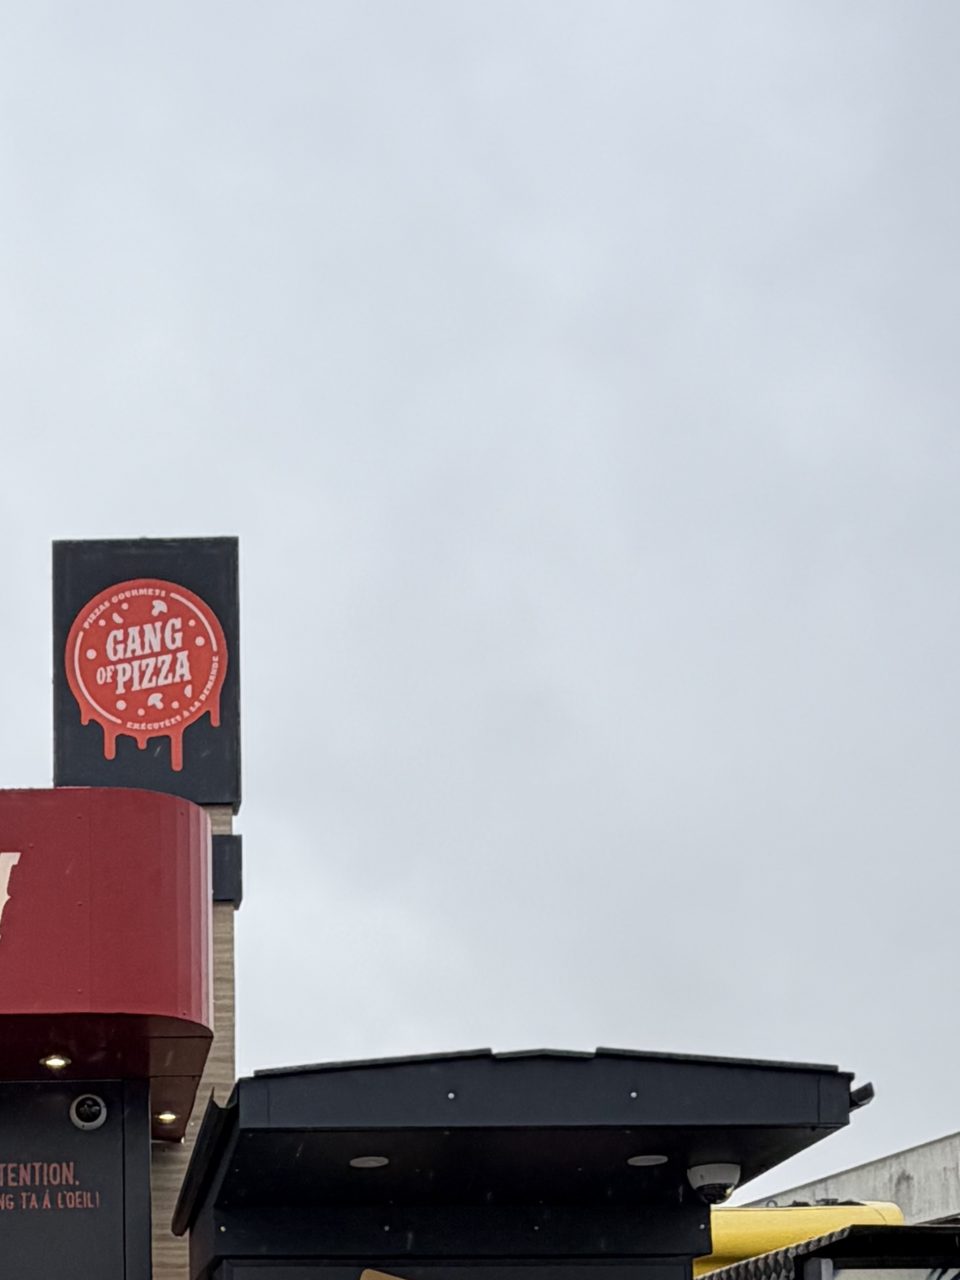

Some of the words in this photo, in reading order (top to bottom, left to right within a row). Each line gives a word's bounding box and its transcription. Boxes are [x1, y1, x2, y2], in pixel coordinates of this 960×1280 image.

[106, 617, 183, 661] GANG
[96, 664, 115, 685] OF
[115, 650, 192, 694] PIZZA
